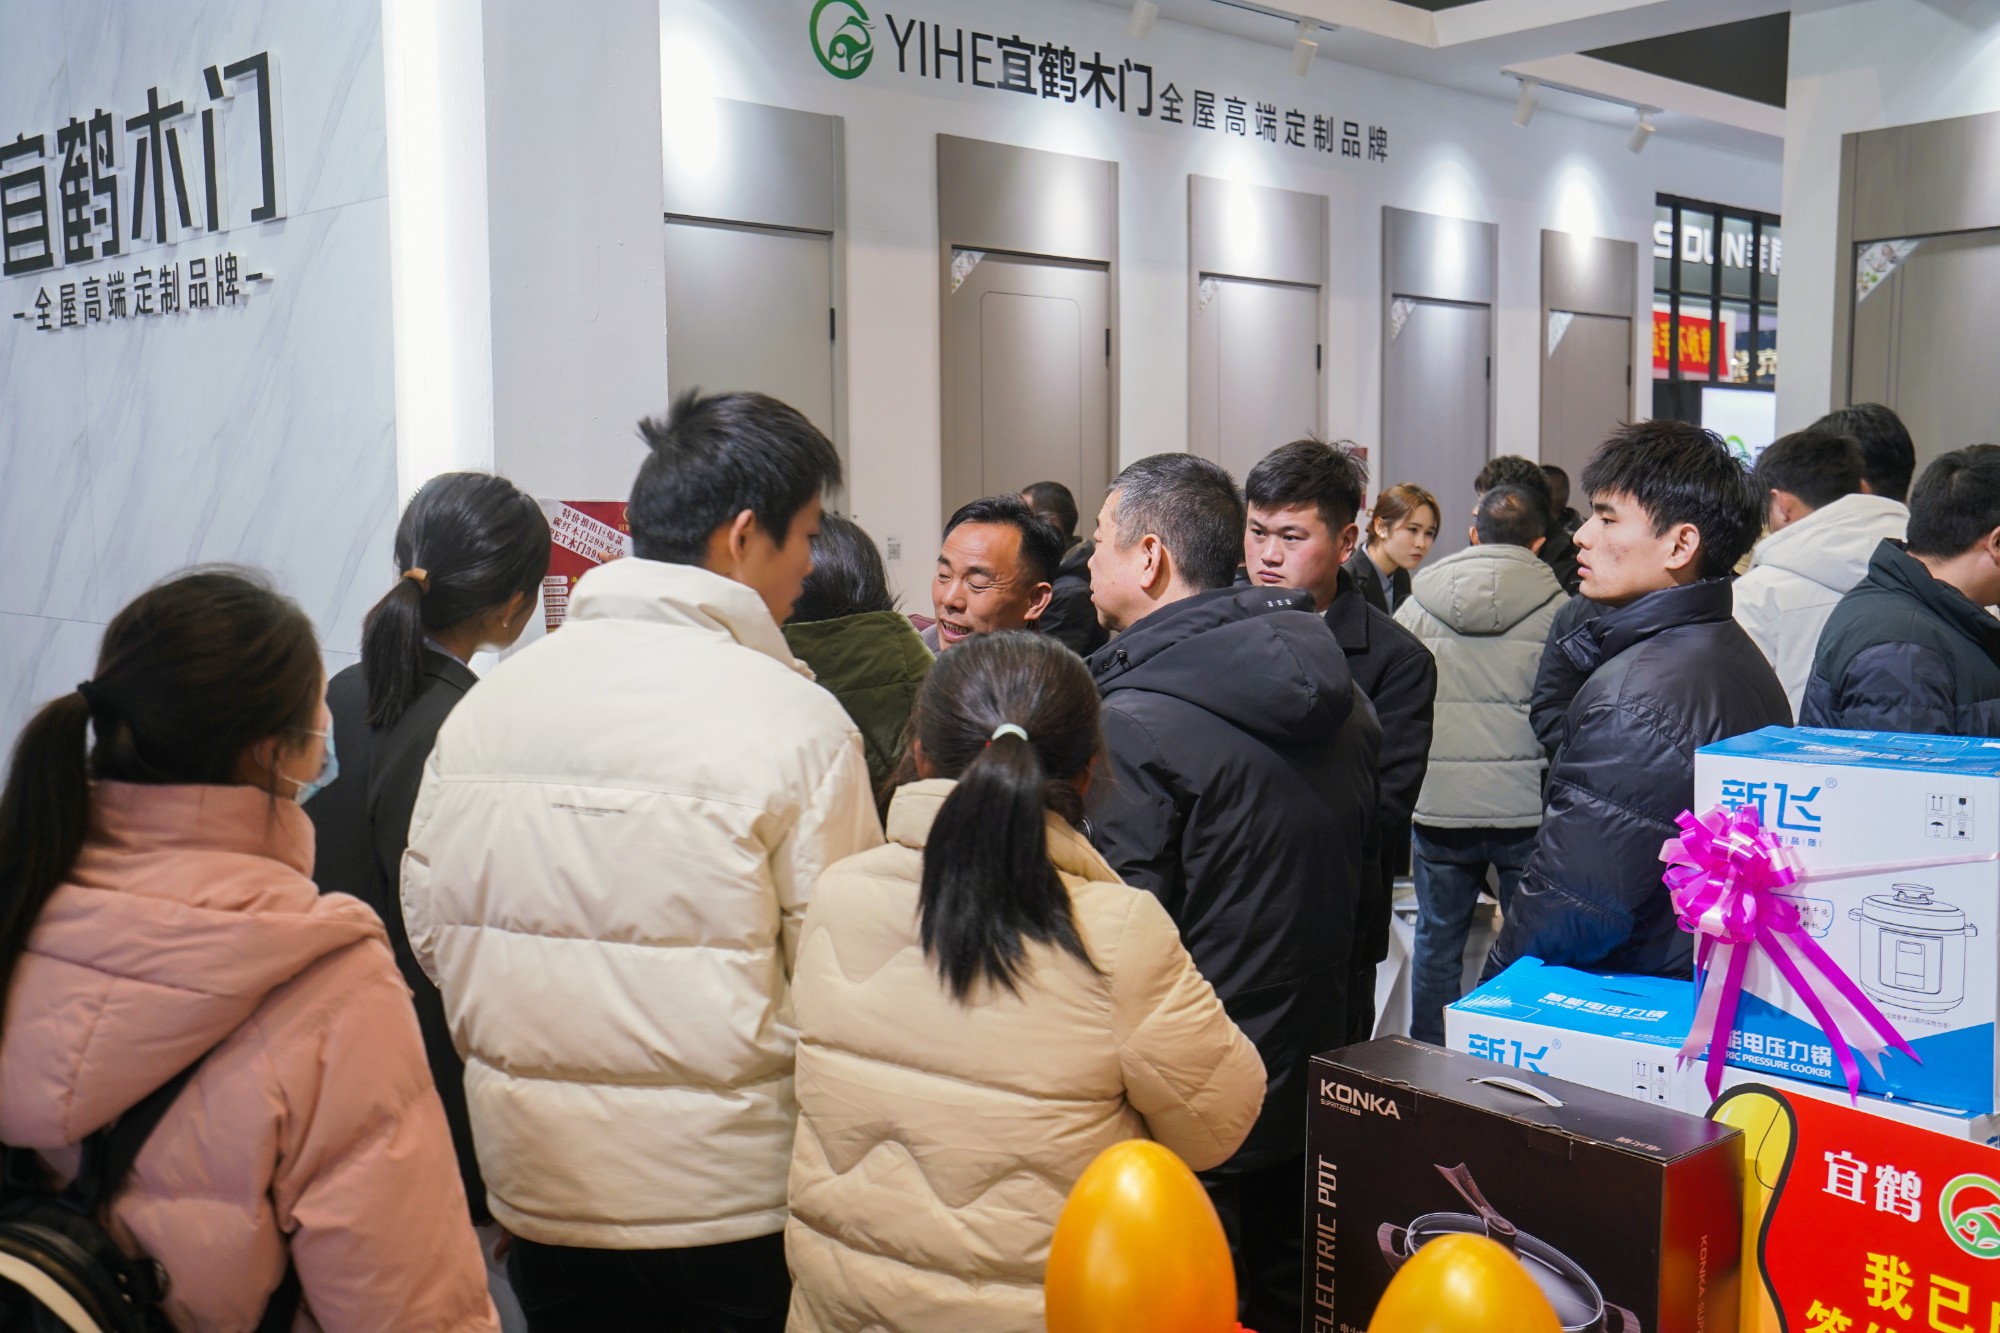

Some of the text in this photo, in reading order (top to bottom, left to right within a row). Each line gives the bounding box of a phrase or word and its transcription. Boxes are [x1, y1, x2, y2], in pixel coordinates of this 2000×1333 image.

[885, 13, 996, 90] YIHE
[996, 35, 1389, 164] 宜鹤木门 全屋高端定制品牌
[0, 51, 275, 276] 宜鹤木门
[34, 251, 241, 331] 全屋高端定制品牌
[1709, 1029, 1832, 1068] 能电压力锅
[1742, 1054, 1790, 1071] PRESSURE
[1790, 1063, 1832, 1079] COOKER
[1320, 1078, 1401, 1121] KONKA
[1821, 1150, 1922, 1223] 宜鹤
[1314, 1154, 1337, 1333] ELECTRIC POT
[1699, 1234, 1708, 1298] KONKA
[1863, 1252, 2000, 1333] 我已
